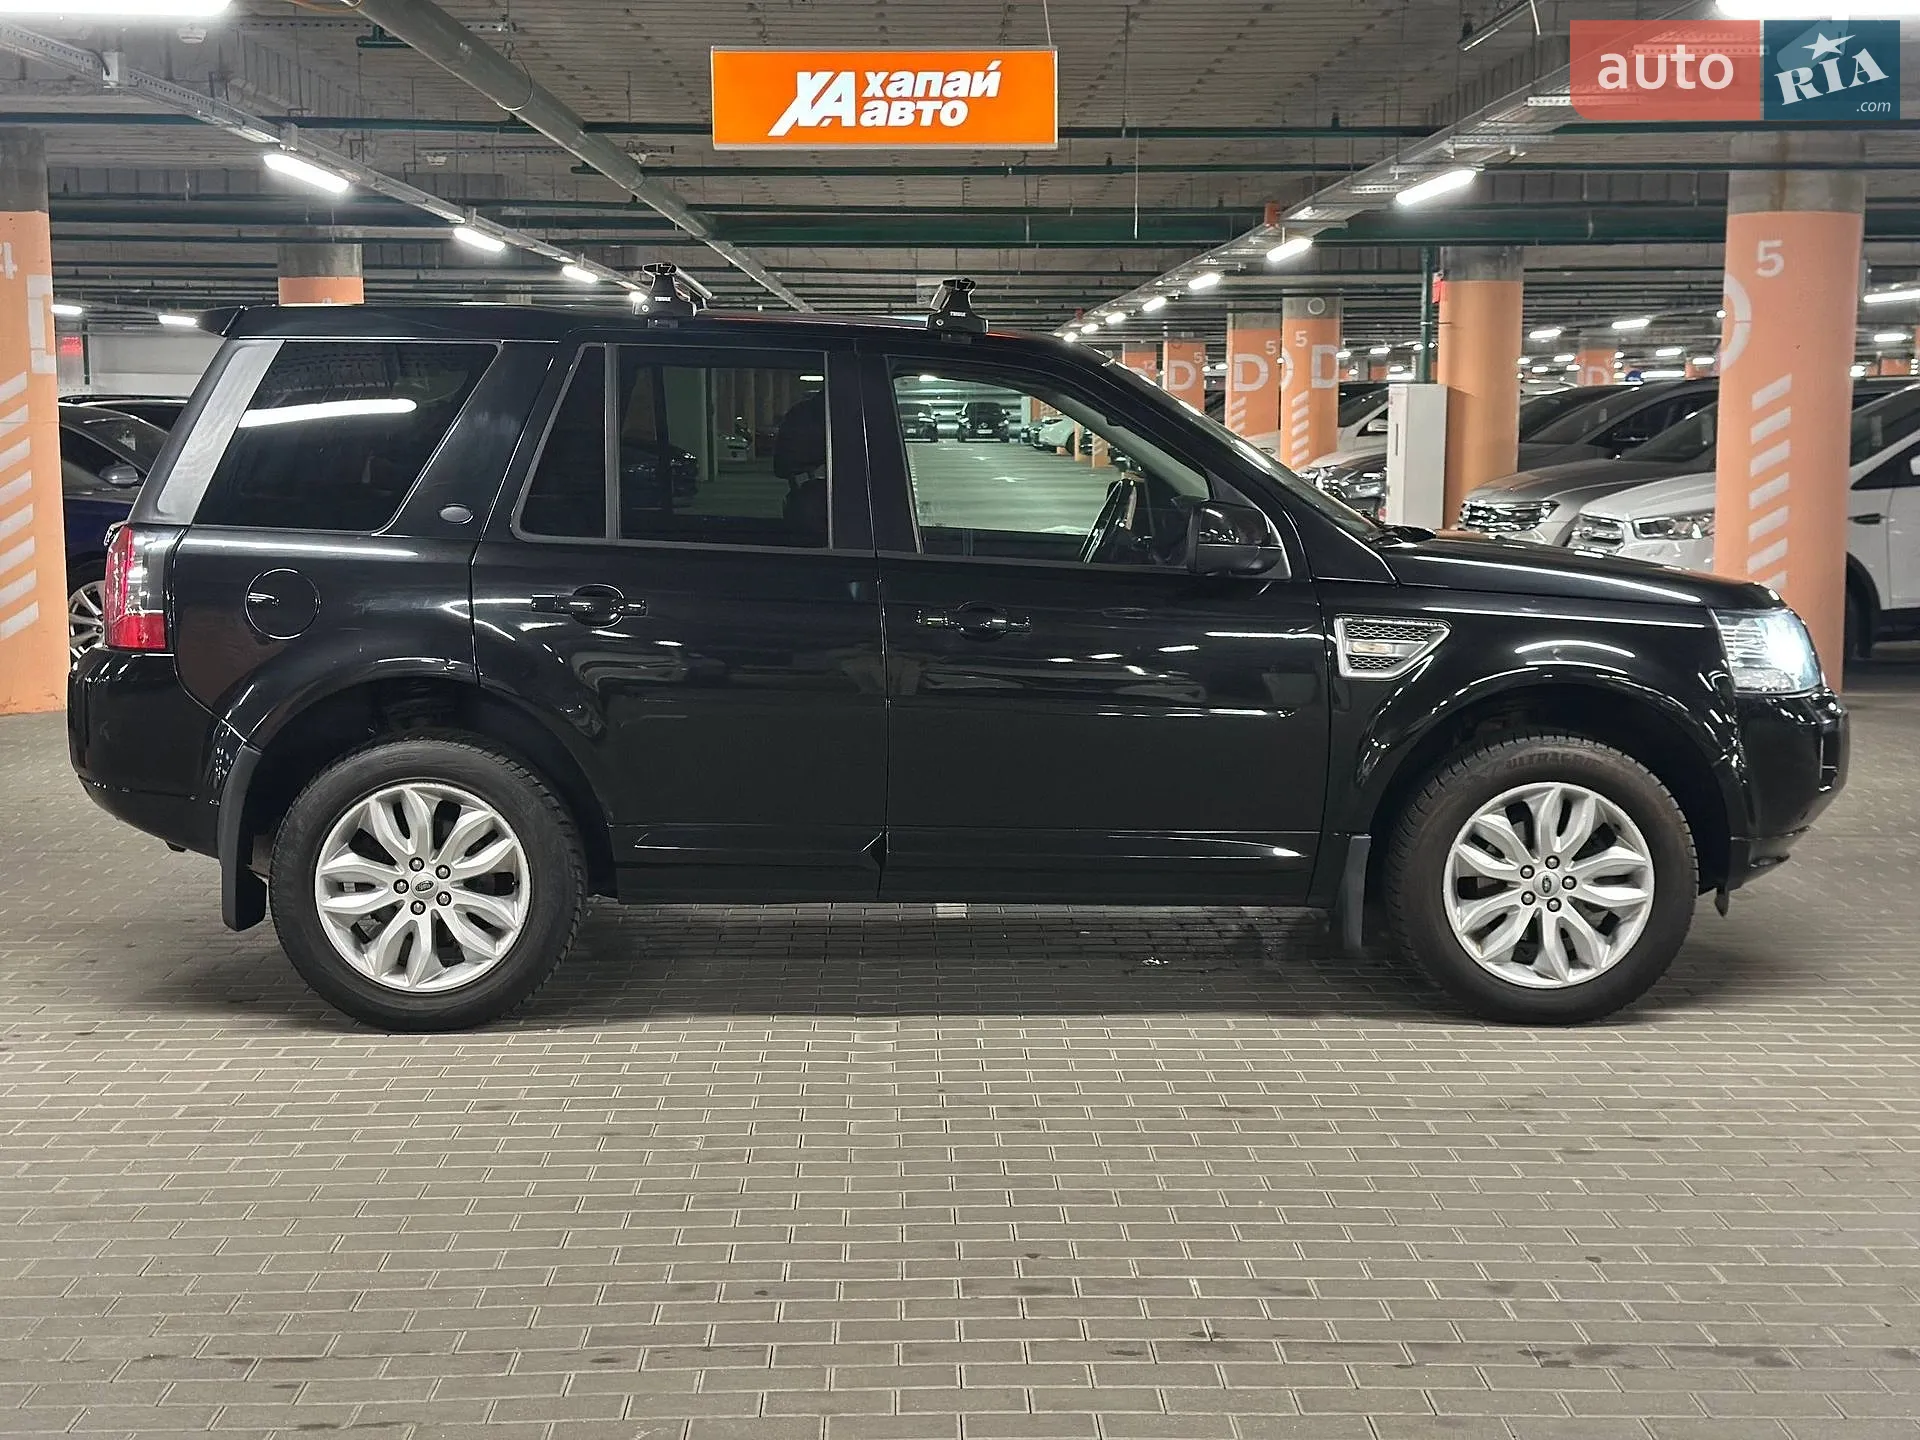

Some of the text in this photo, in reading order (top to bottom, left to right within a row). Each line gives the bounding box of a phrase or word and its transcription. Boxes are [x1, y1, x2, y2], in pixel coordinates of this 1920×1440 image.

[859, 100, 968, 127] авто
[1756, 240, 1785, 278] 5
[1265, 340, 1277, 354] 5
[1295, 331, 1307, 347] 5
[1168, 360, 1197, 390] D
[1234, 353, 1269, 392] D
